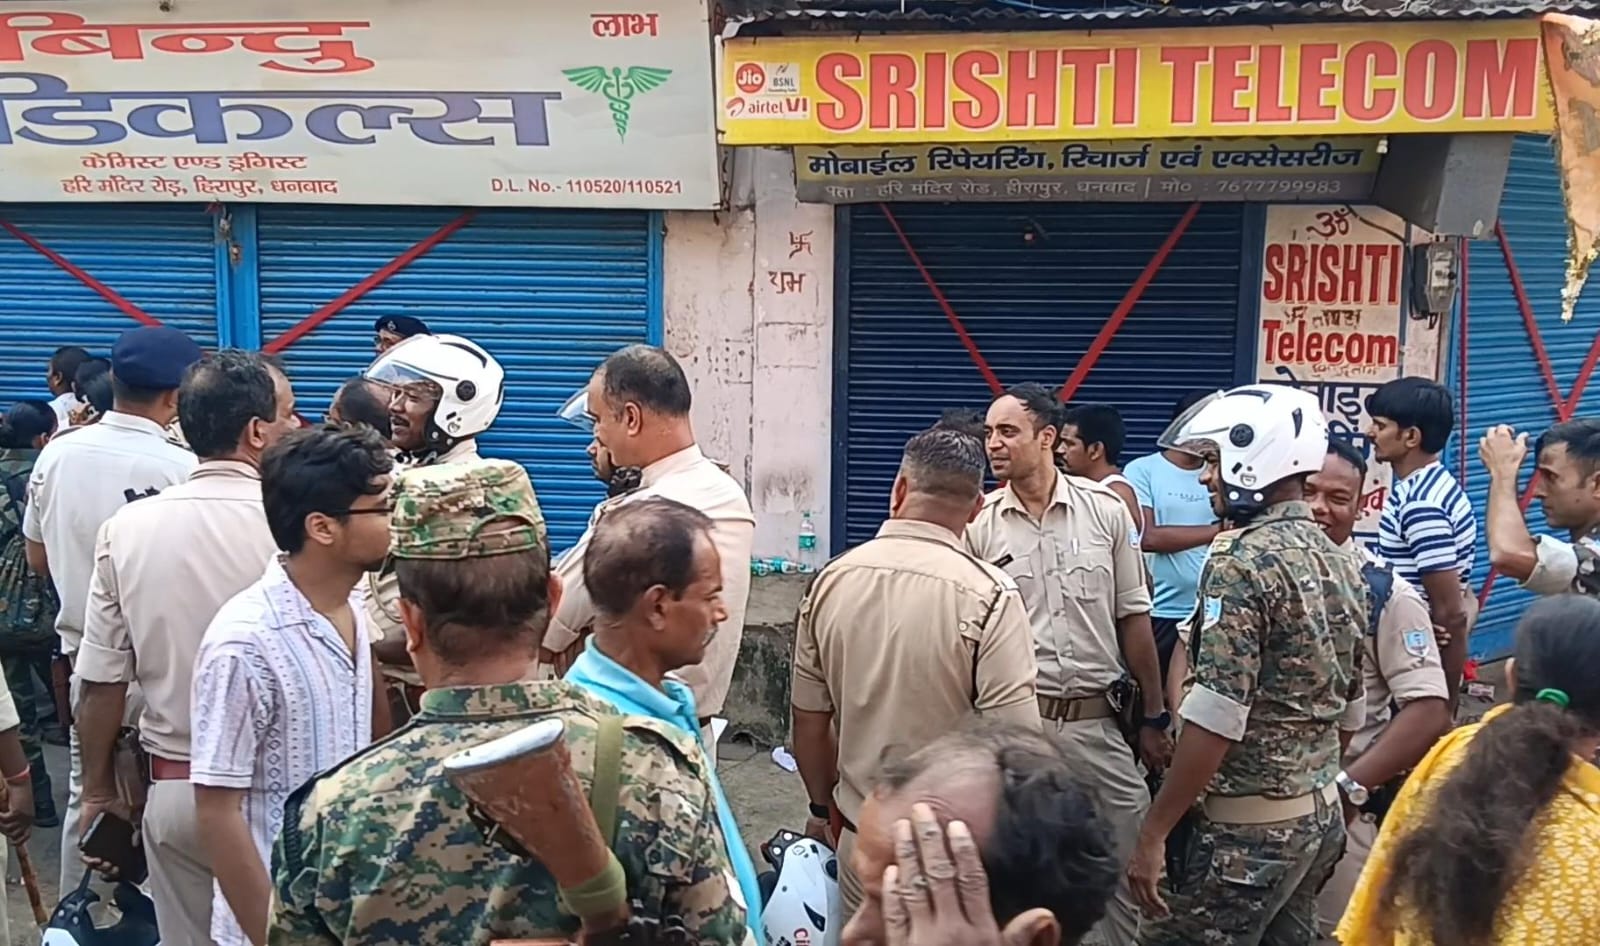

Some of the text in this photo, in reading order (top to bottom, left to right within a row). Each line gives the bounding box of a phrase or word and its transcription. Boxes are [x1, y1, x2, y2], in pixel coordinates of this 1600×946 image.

[590, 13, 658, 37] लाभ
[738, 69, 763, 85] Jio
[773, 78, 795, 87] BSNL
[816, 38, 1538, 130] SRISHTI TELECOM
[748, 100, 784, 113] airtel
[80, 153, 308, 173] केमिस्ट एण्ड ड्रगिस्ट
[808, 142, 1364, 176] मोबाईल रिपेयरिंग, रिचार्ज एवं एक्सेसरीज
[61, 176, 93, 193] हरि
[271, 180, 338, 194] धनबाद
[491, 178, 683, 194] D.L. No.- 110520/110521
[877, 180, 902, 195] हरि
[911, 180, 953, 195] मंदिर
[1077, 182, 1137, 193] धनबाद
[1216, 181, 1341, 193] 7677799983
[1264, 244, 1399, 304] SRISHTI
[1262, 320, 1397, 365] Telecom
